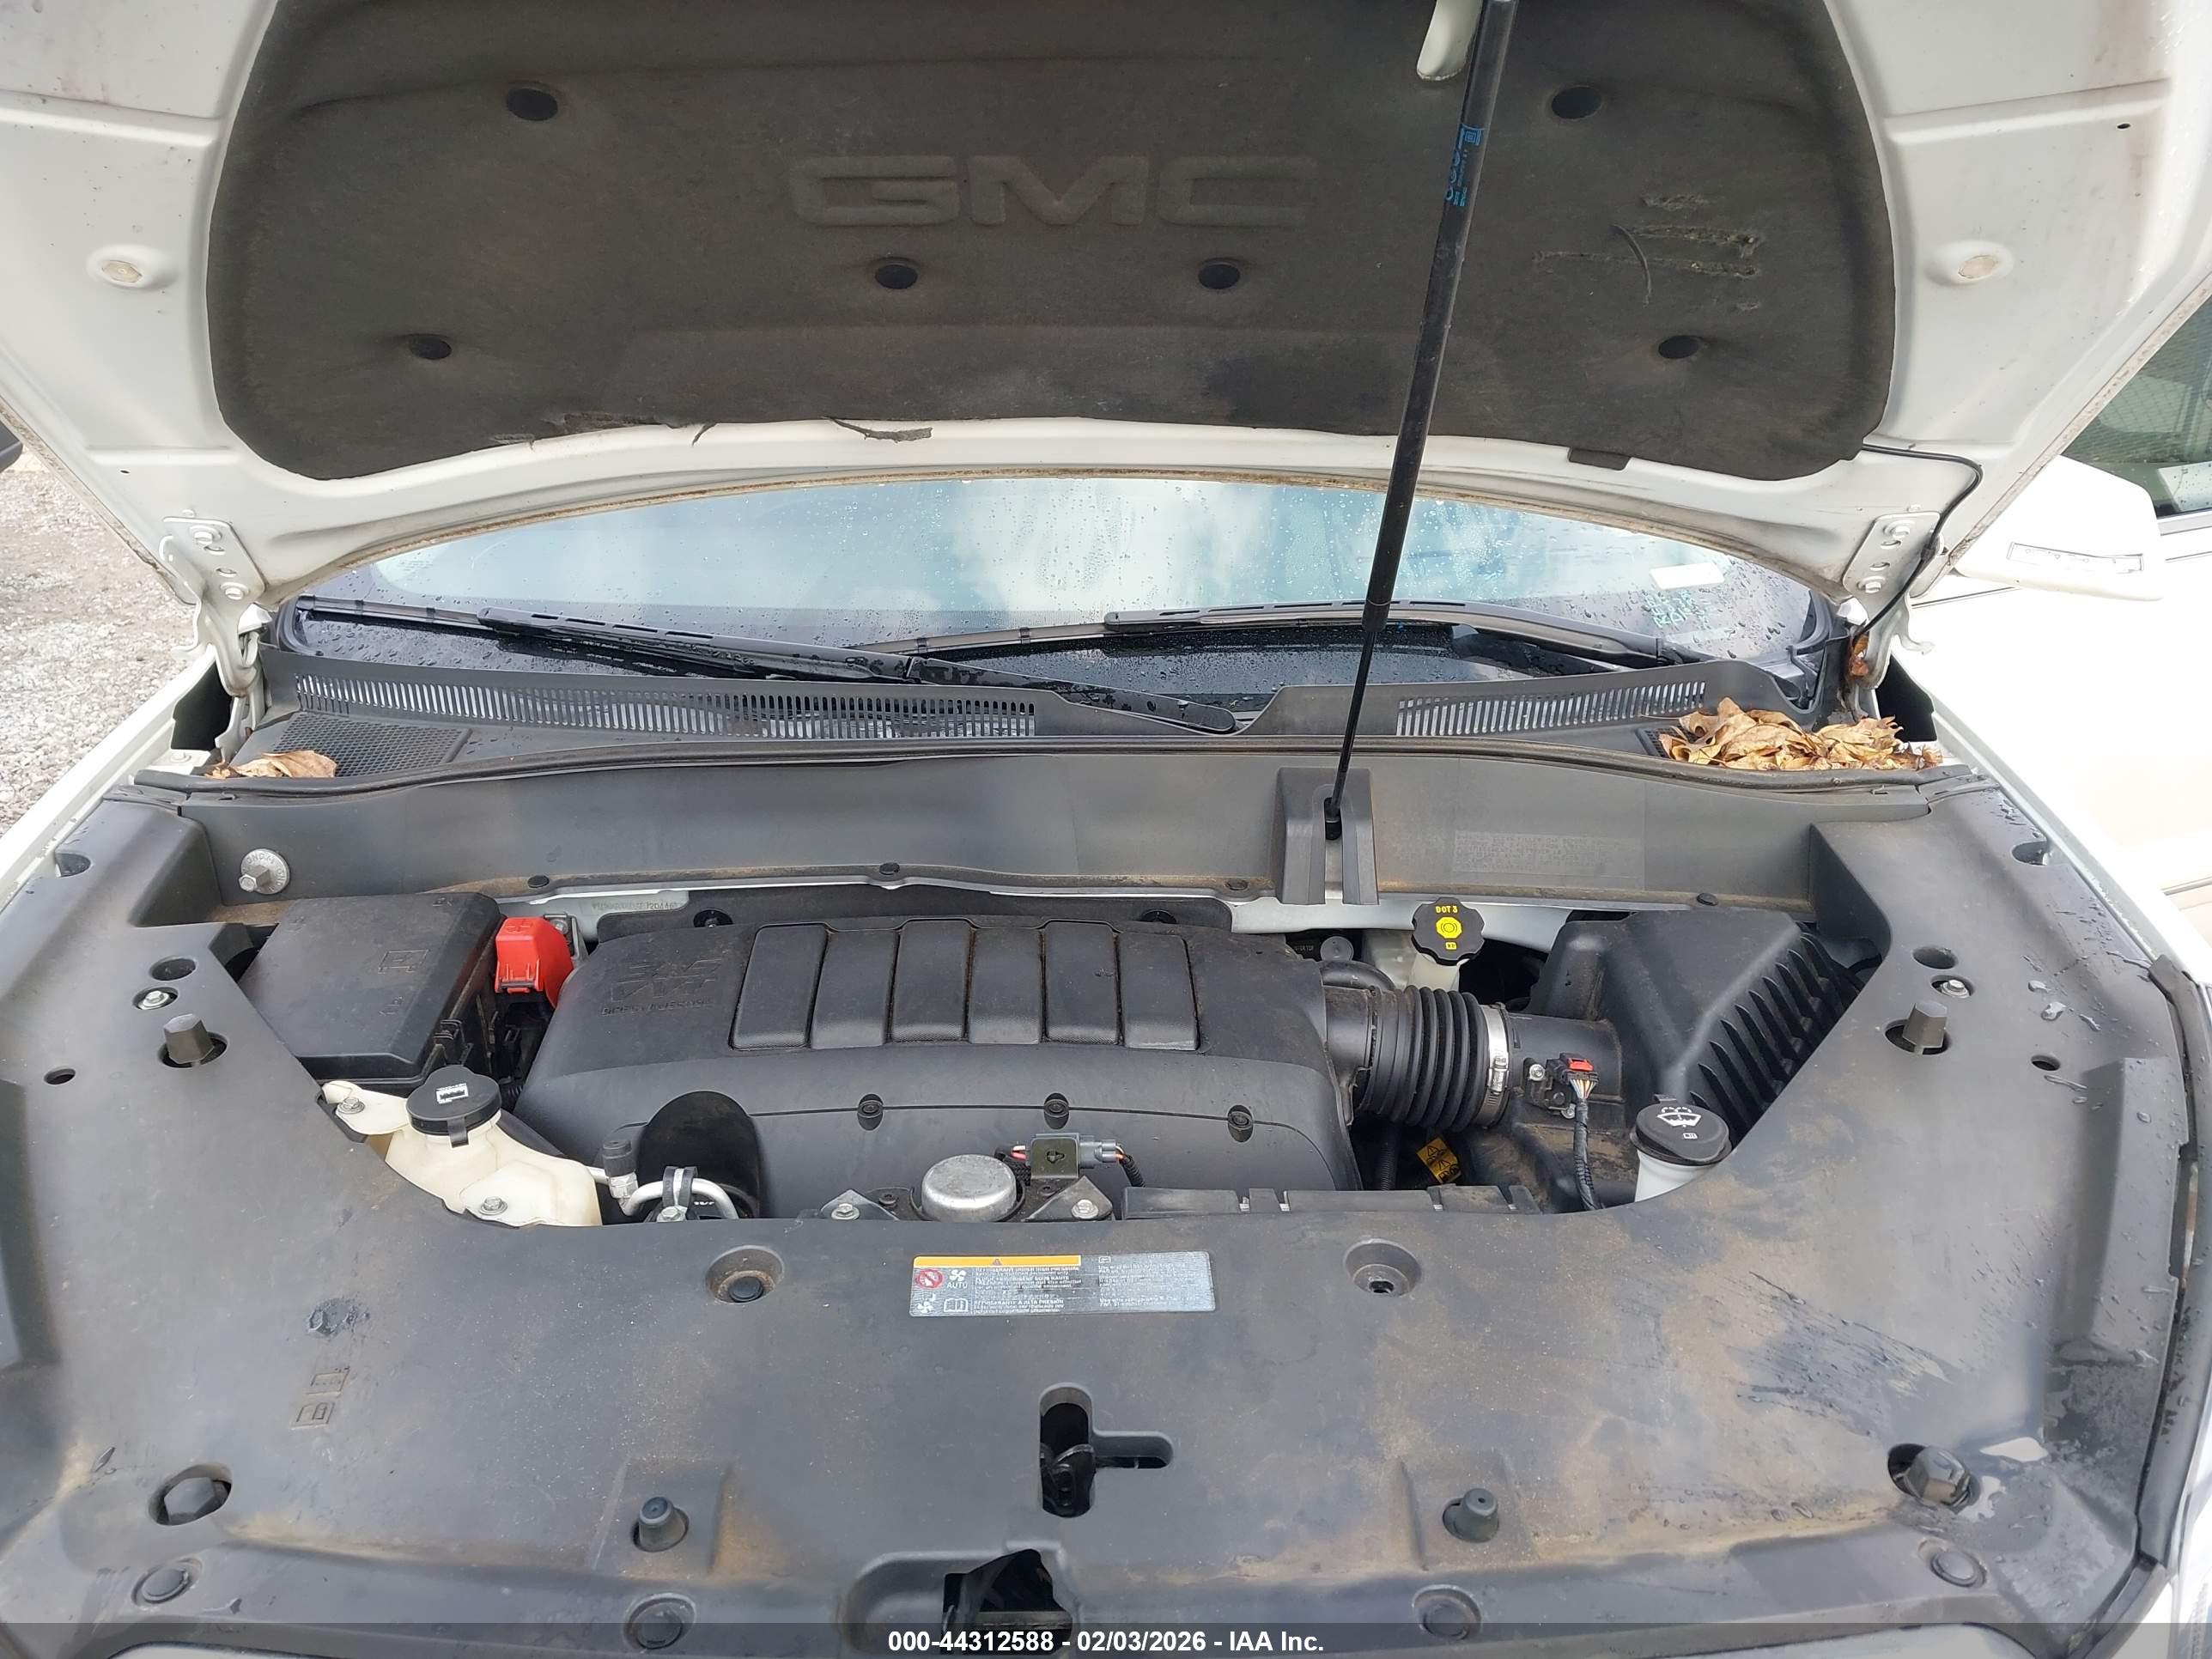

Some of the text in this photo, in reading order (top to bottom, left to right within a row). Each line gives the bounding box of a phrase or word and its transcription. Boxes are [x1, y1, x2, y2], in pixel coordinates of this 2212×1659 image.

[790, 155, 1317, 227] GMC
[1435, 905, 1458, 914] DOT 3
